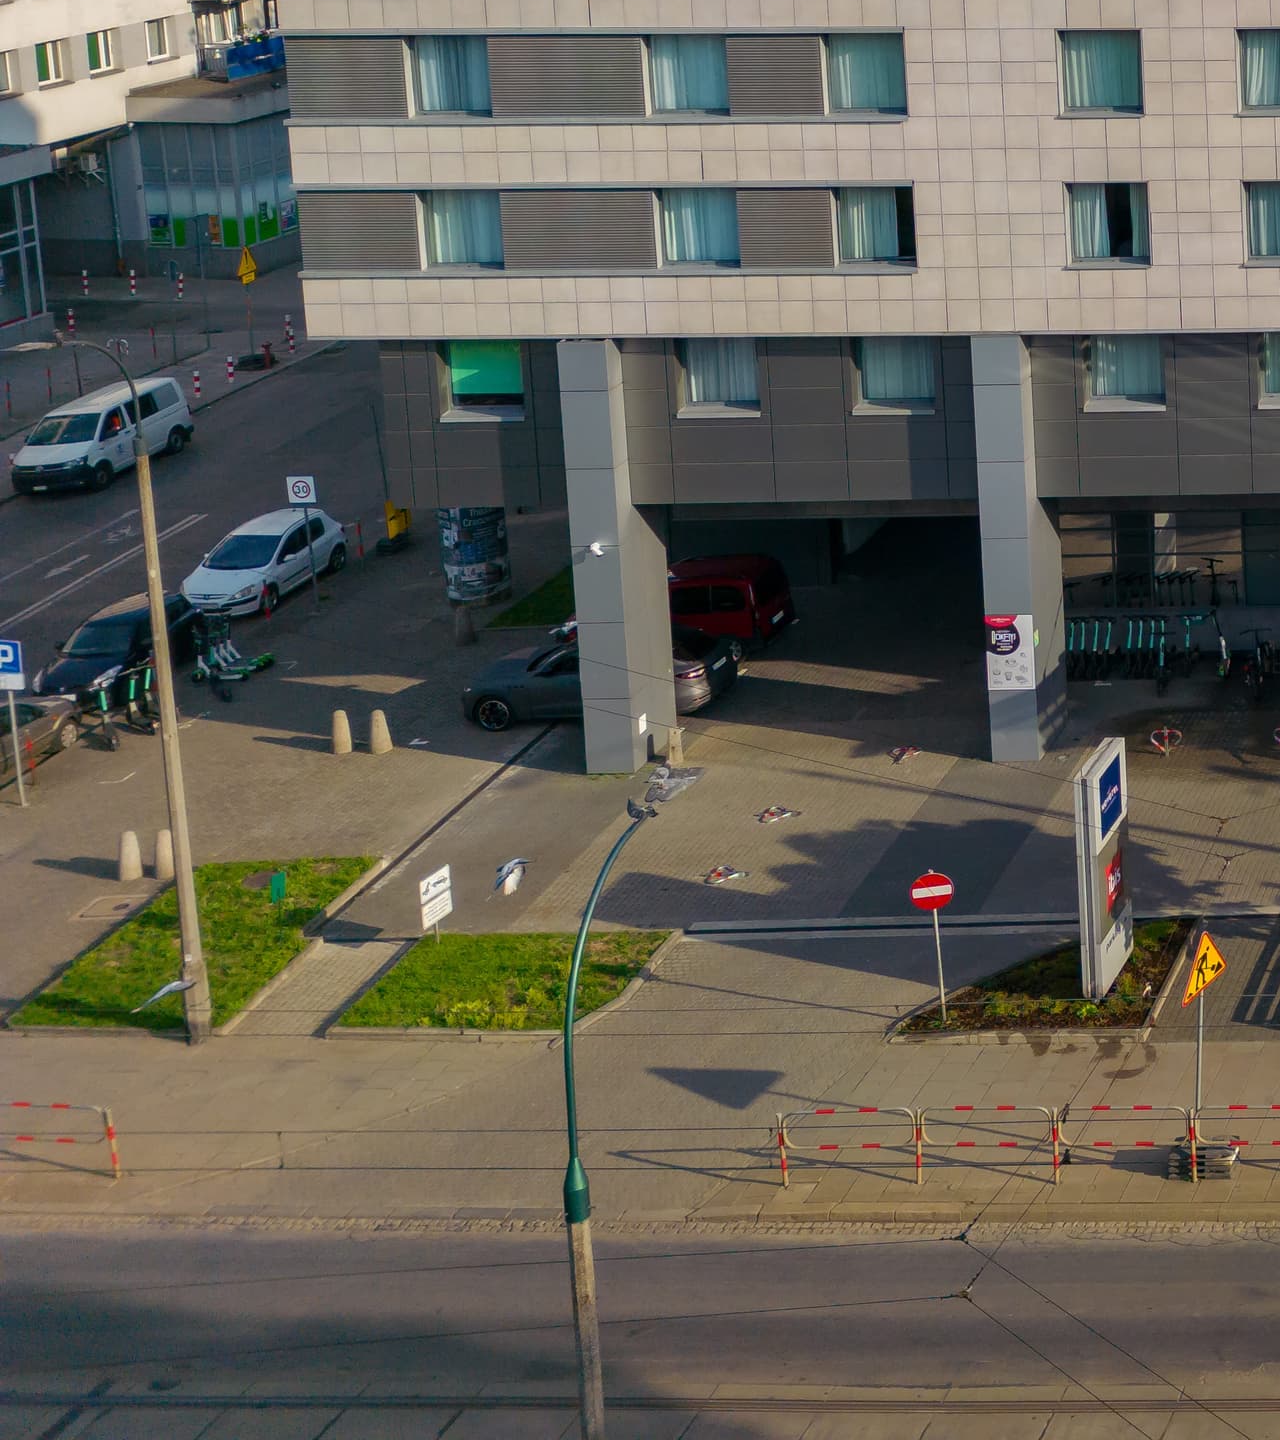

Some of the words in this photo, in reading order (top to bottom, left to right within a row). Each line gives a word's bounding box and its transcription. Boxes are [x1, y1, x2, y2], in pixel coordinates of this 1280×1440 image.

[294, 484, 308, 495] 30
[0, 644, 14, 669] P
[1107, 866, 1121, 896] ibis
